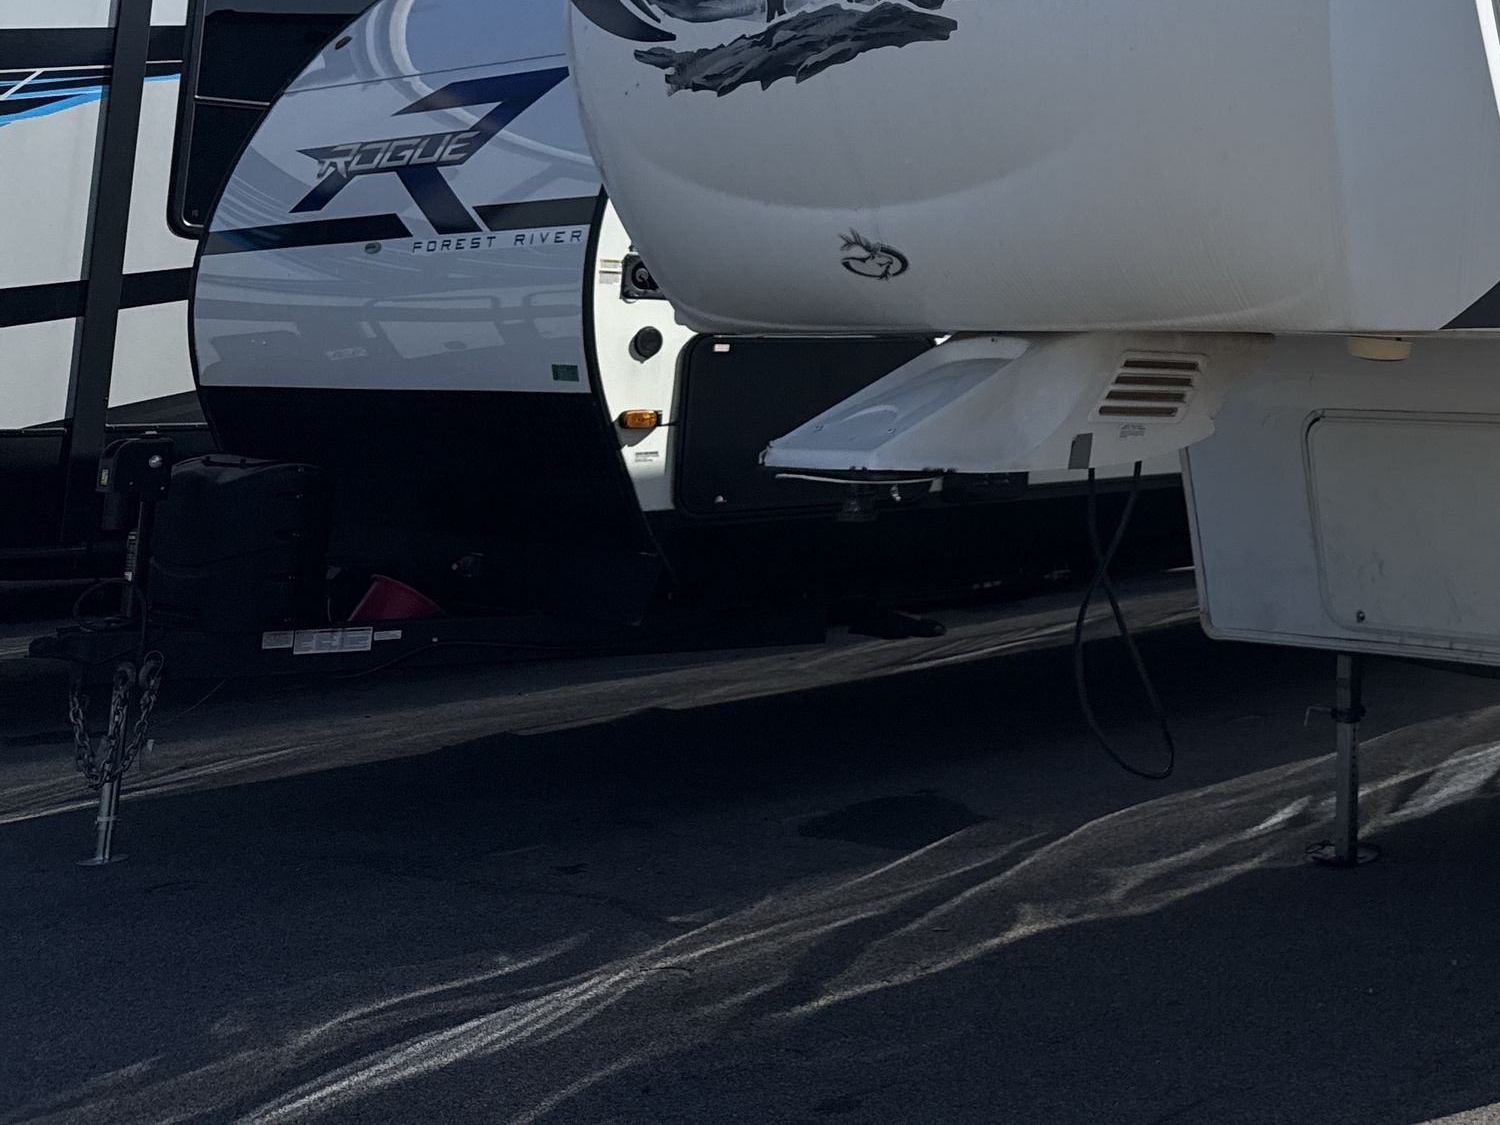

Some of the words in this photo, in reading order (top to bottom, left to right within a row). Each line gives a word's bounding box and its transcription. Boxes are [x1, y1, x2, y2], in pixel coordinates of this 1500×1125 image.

[316, 131, 481, 179] ROGUE
[412, 236, 496, 253] FOREST
[513, 230, 583, 246] RIVER
